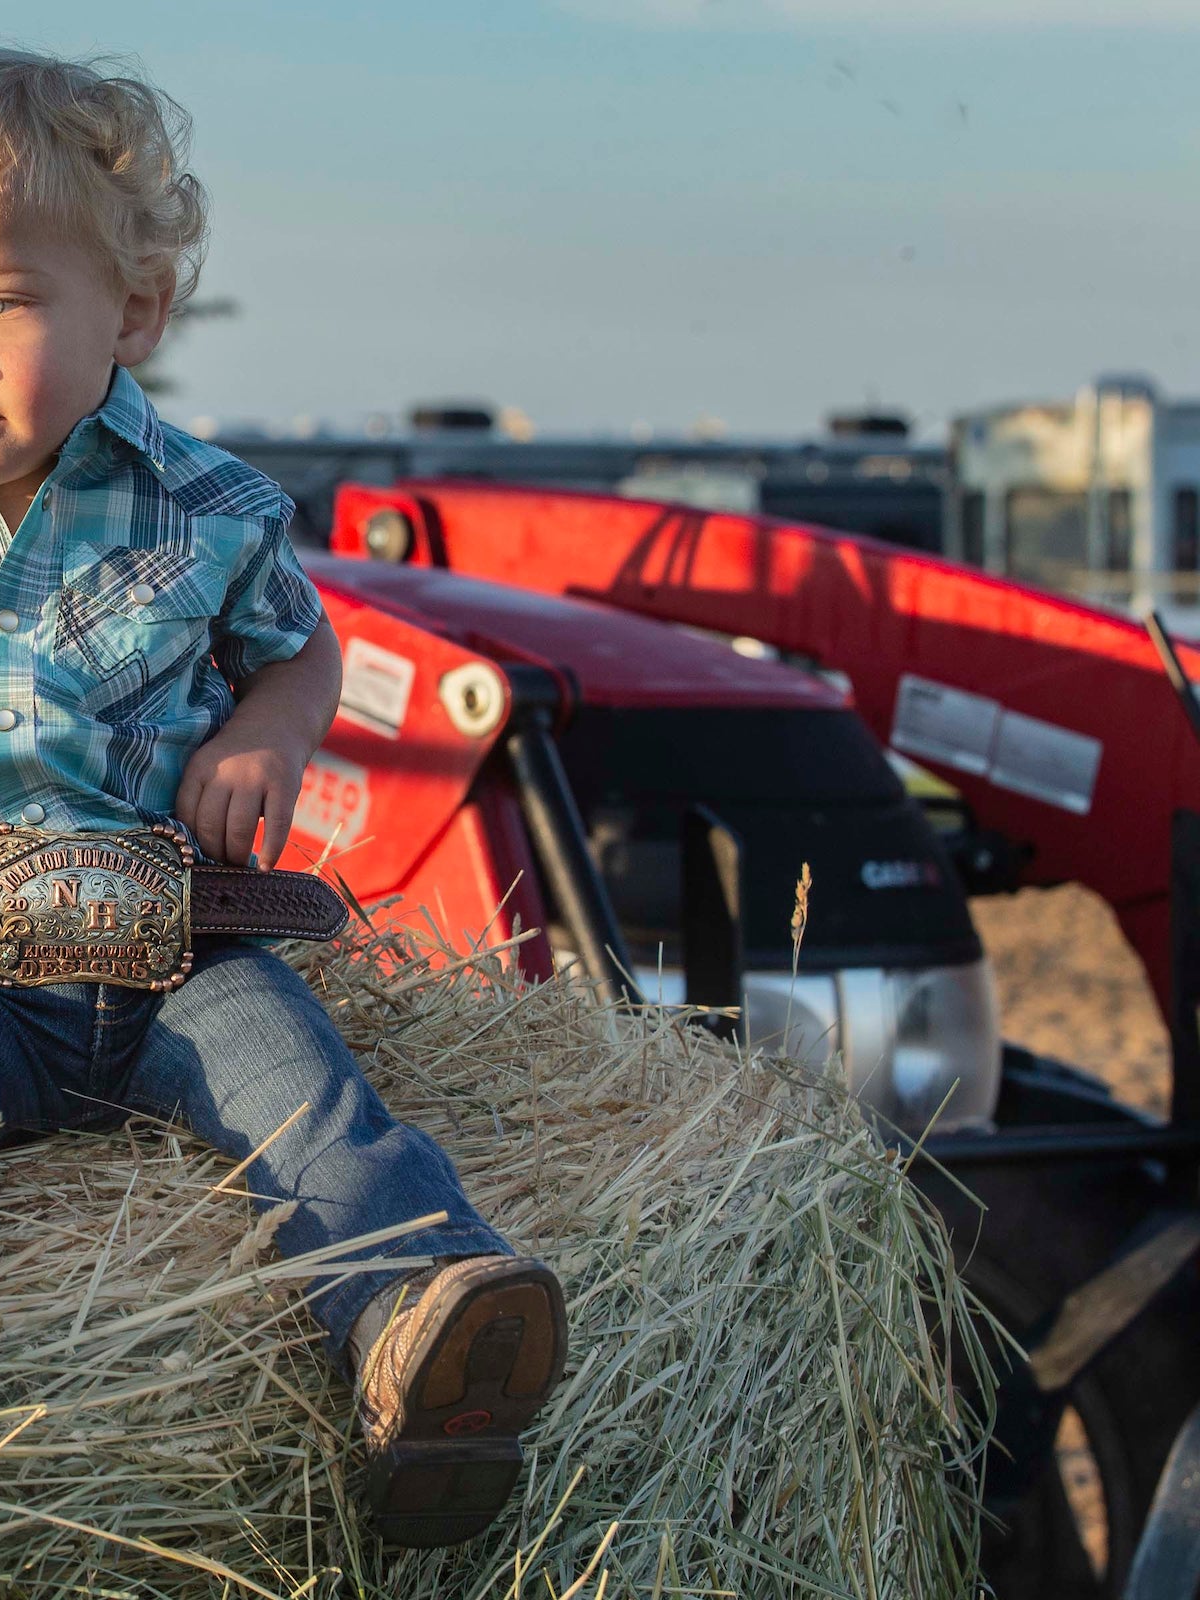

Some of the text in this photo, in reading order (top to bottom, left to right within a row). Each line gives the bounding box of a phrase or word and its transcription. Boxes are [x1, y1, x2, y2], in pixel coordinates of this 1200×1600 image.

[0, 848, 168, 895] NOAH CODY HOWARD HANNA
[52, 879, 81, 908] N
[4, 898, 27, 913] 20
[87, 901, 119, 930] H
[141, 901, 163, 915] 21
[24, 944, 145, 959] KICKING COWBOY
[18, 959, 148, 980] DESIGNS
